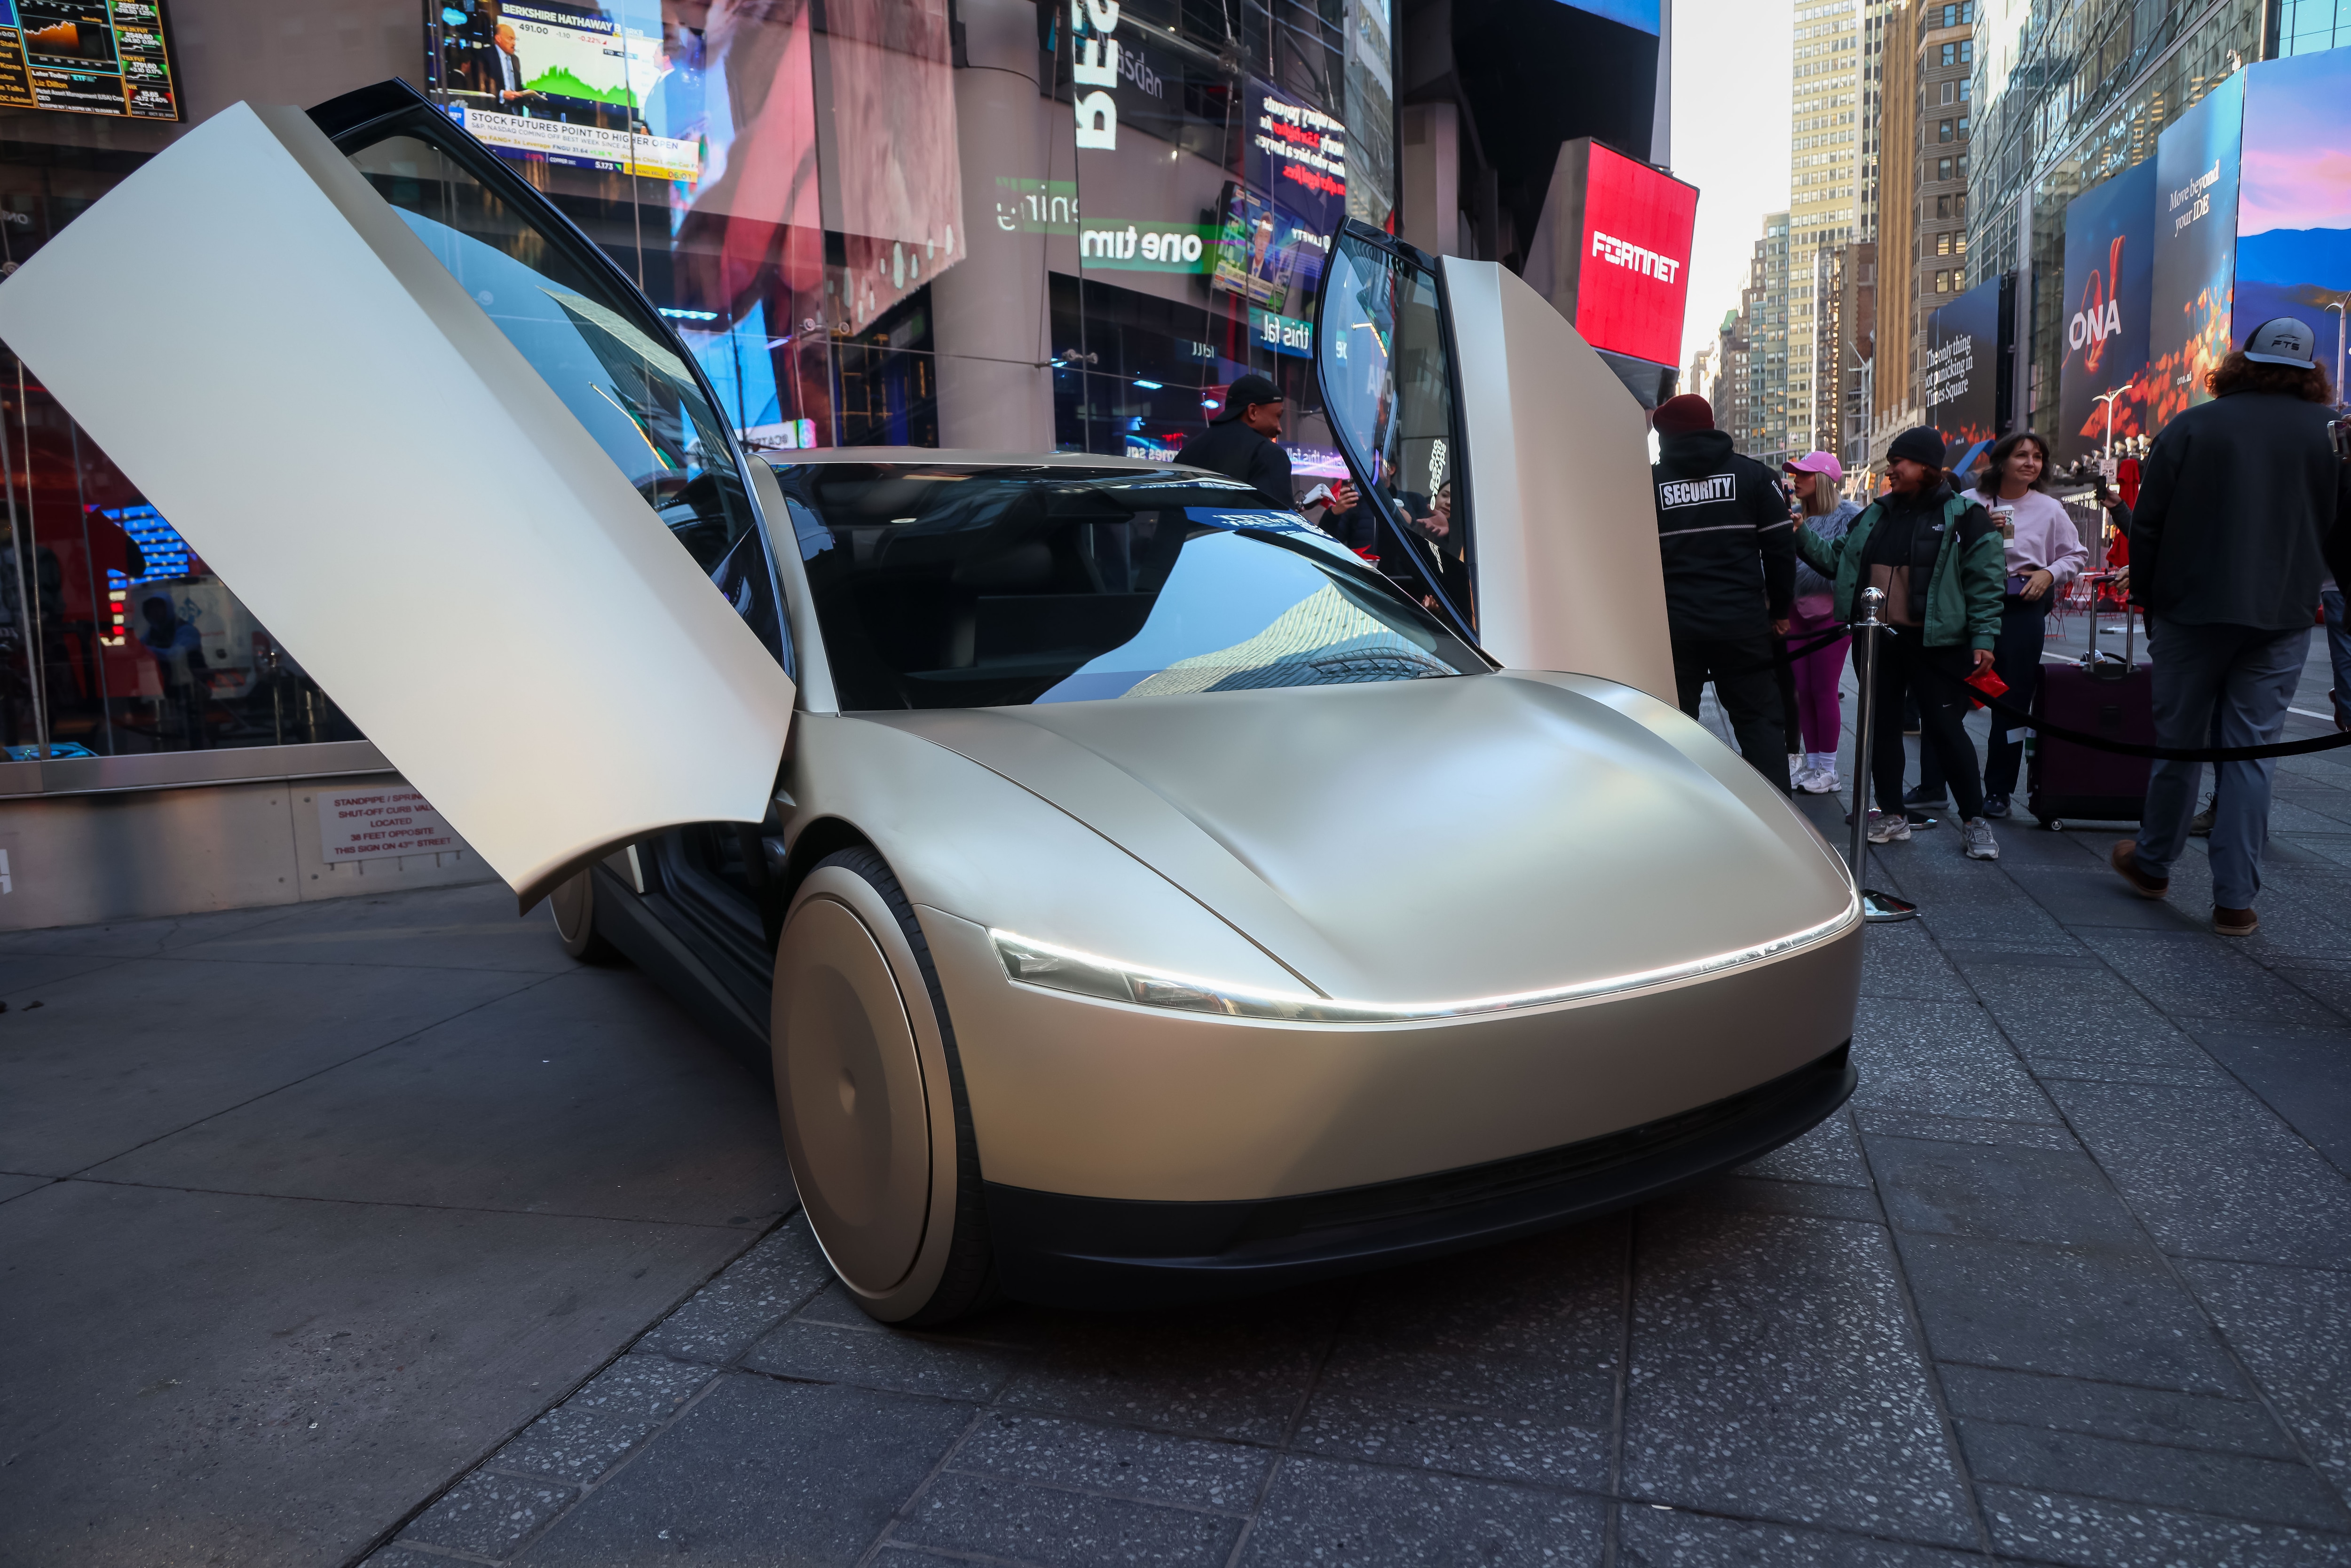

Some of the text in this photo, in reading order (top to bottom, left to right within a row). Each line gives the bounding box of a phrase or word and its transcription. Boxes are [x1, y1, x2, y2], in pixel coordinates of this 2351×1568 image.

[502, 3, 557, 23] BERKSHIRE
[558, 13, 613, 32] HATHAWAY
[614, 23, 621, 32] B
[519, 24, 548, 35] 491.00
[472, 113, 507, 125] STOCK
[511, 119, 558, 132] FUTURES
[562, 126, 592, 137] POINT
[652, 140, 678, 150] OPEN
[488, 125, 517, 134] NASDAQ
[519, 129, 546, 138] COMING
[595, 161, 614, 170] 5.173
[2169, 158, 2220, 212] Move beyond
[2175, 193, 2209, 238] your IDE
[1592, 230, 1680, 284] FORTINET
[2069, 299, 2122, 351] ONA
[1926, 334, 1971, 369] The only thing
[2272, 340, 2300, 351] FTS
[1934, 357, 1965, 390] panicking
[1966, 355, 1973, 371] in
[2177, 371, 2192, 386] ona.ai
[1926, 378, 1969, 408] Times Square
[1663, 478, 1732, 505] SECURITY
[334, 796, 386, 807] STANDPIPE
[339, 808, 383, 819] SHUT-OFF
[386, 805, 411, 814] CURB
[363, 831, 386, 840] FEET
[388, 827, 434, 838] OPPOSITE
[371, 818, 412, 827] LOCATED
[335, 846, 355, 854] THIS
[358, 844, 380, 852] SIGN
[417, 837, 451, 847] STREET
